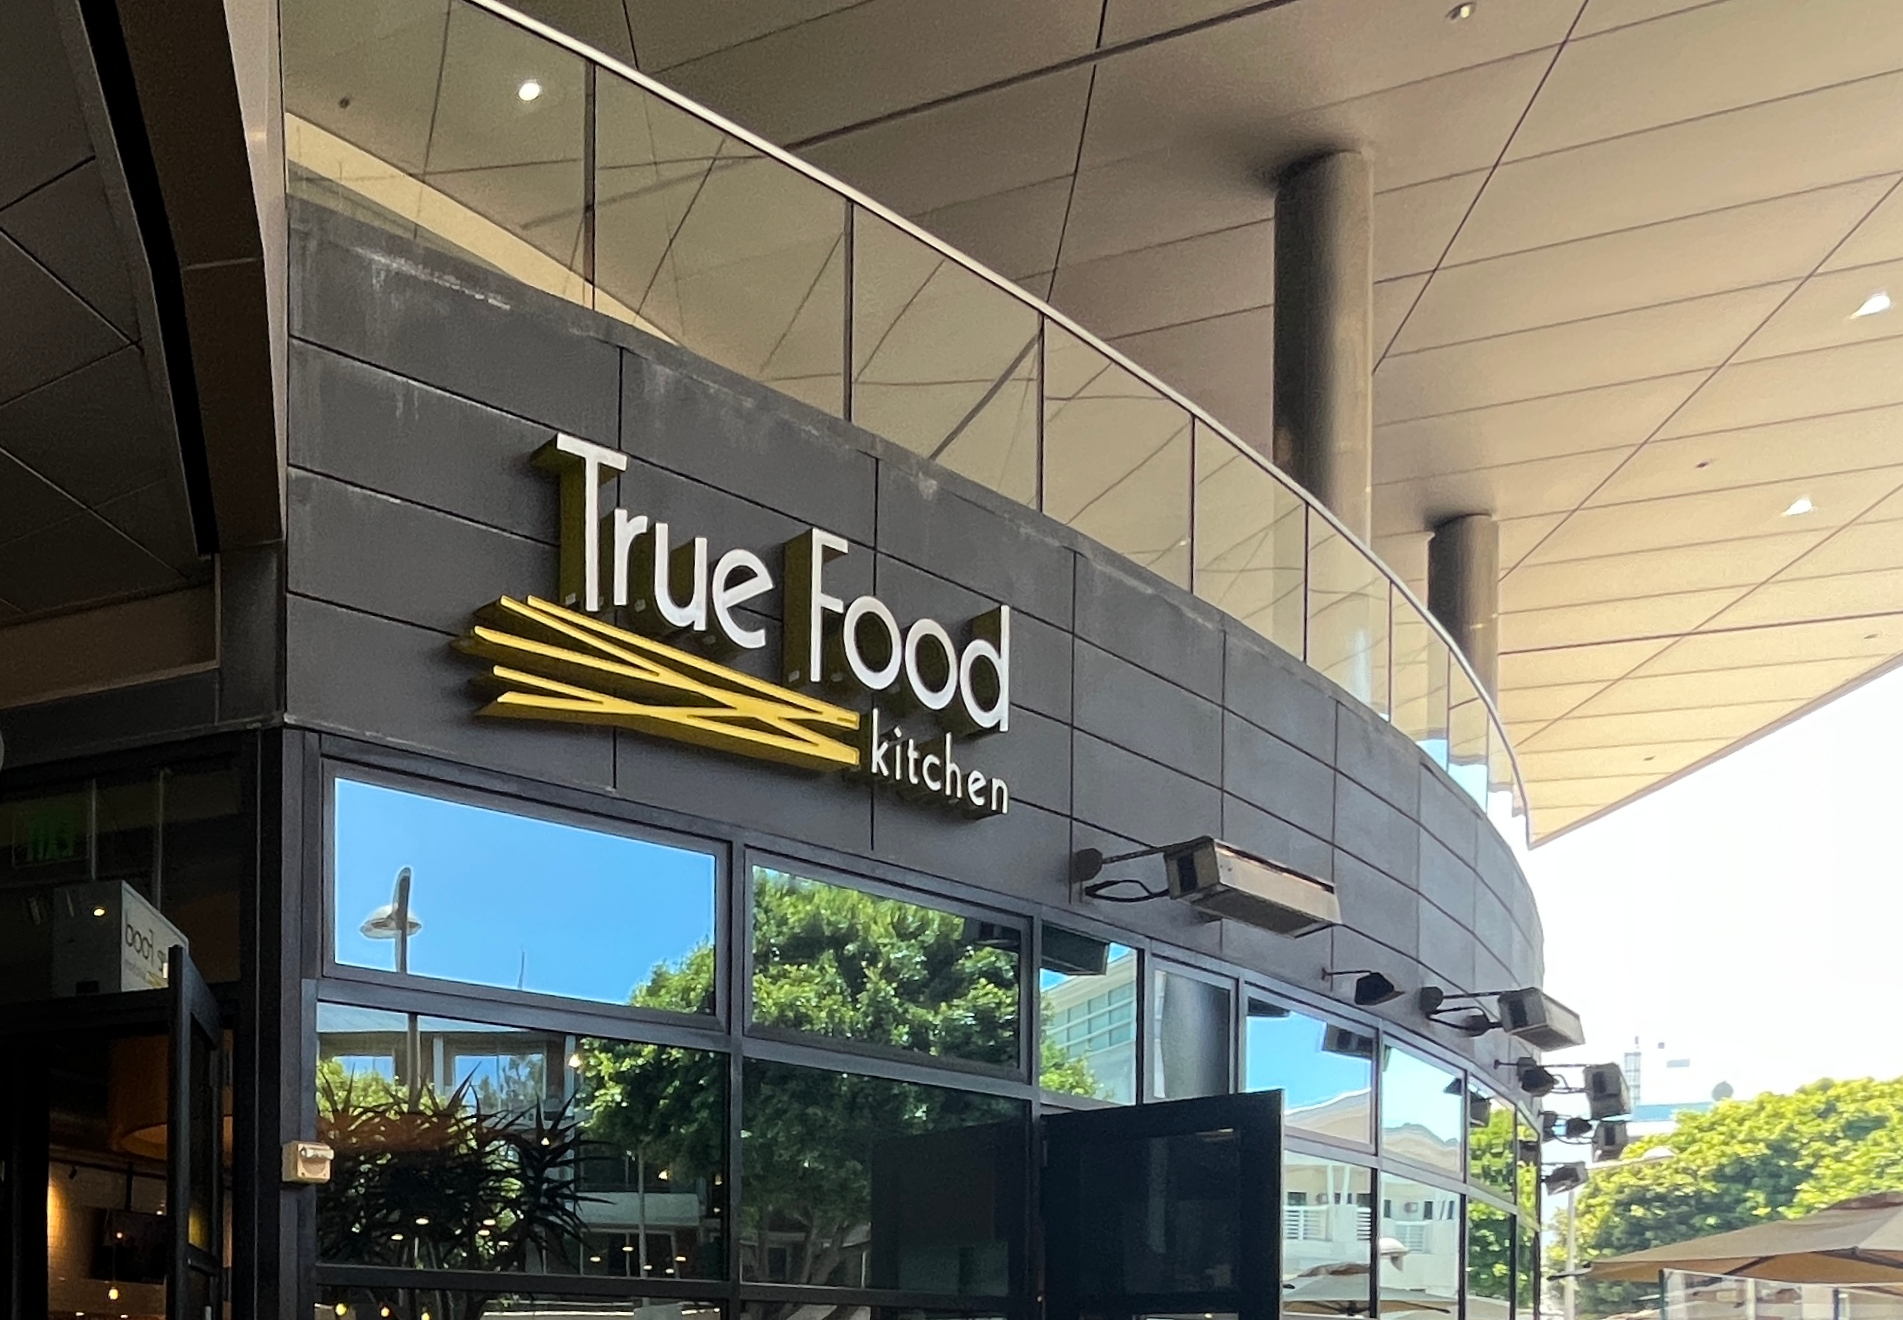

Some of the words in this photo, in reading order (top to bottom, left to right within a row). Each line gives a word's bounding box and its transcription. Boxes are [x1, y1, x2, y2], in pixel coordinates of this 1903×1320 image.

[556, 433, 775, 649] True
[809, 529, 1010, 733] Food
[871, 708, 1010, 814] kitchen
